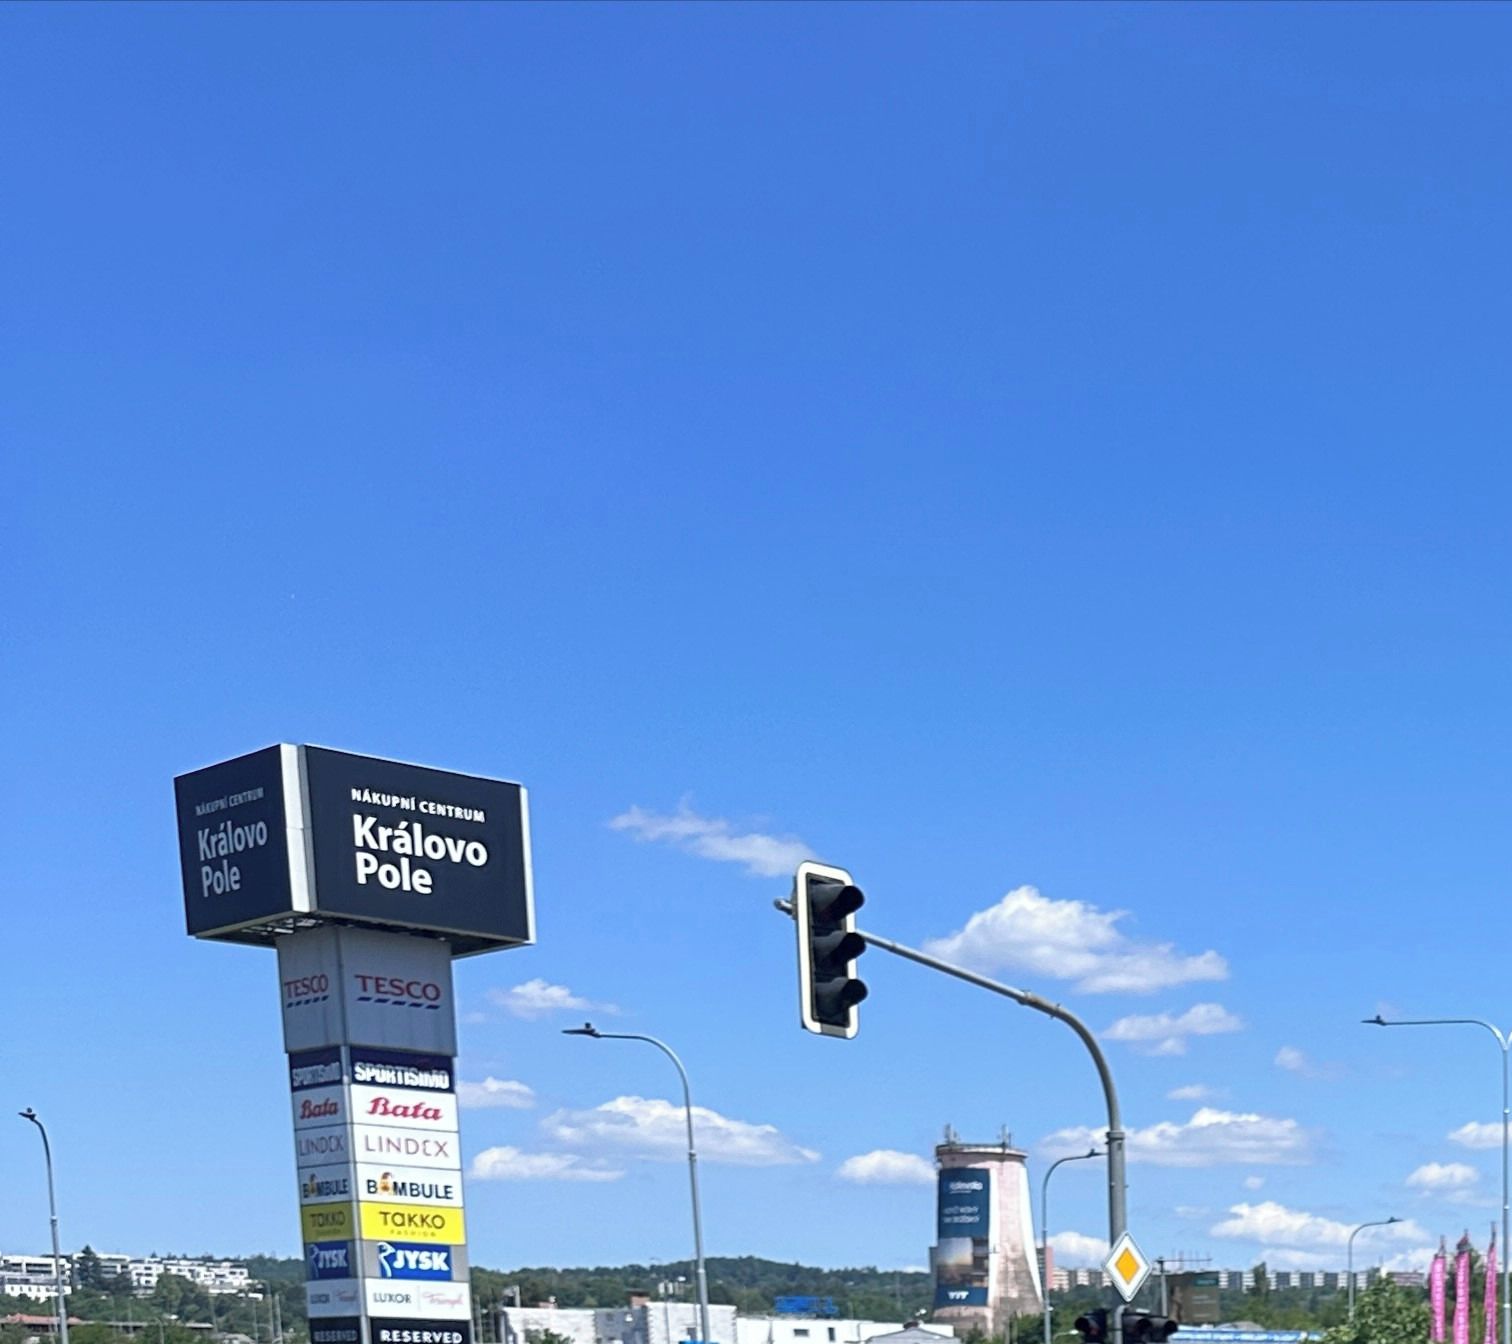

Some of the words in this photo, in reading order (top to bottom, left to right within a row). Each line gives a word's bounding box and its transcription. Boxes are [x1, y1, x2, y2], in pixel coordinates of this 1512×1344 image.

[351, 787, 416, 812] NÁKUPNÍ
[419, 800, 486, 823] CENTRUM
[197, 820, 268, 861] Královo
[353, 814, 489, 867] Královo
[201, 858, 241, 897] Pole
[355, 852, 433, 895] Pole
[284, 974, 329, 999] TESCO
[355, 974, 441, 1001] TESCO
[354, 1061, 450, 1090] SPORTISIMO
[364, 1134, 450, 1158] LINDEX
[318, 1249, 348, 1268] JYSK
[393, 1250, 450, 1271] JYSK
[373, 1292, 411, 1304] LUXOR
[380, 1330, 462, 1344] RESERVED
